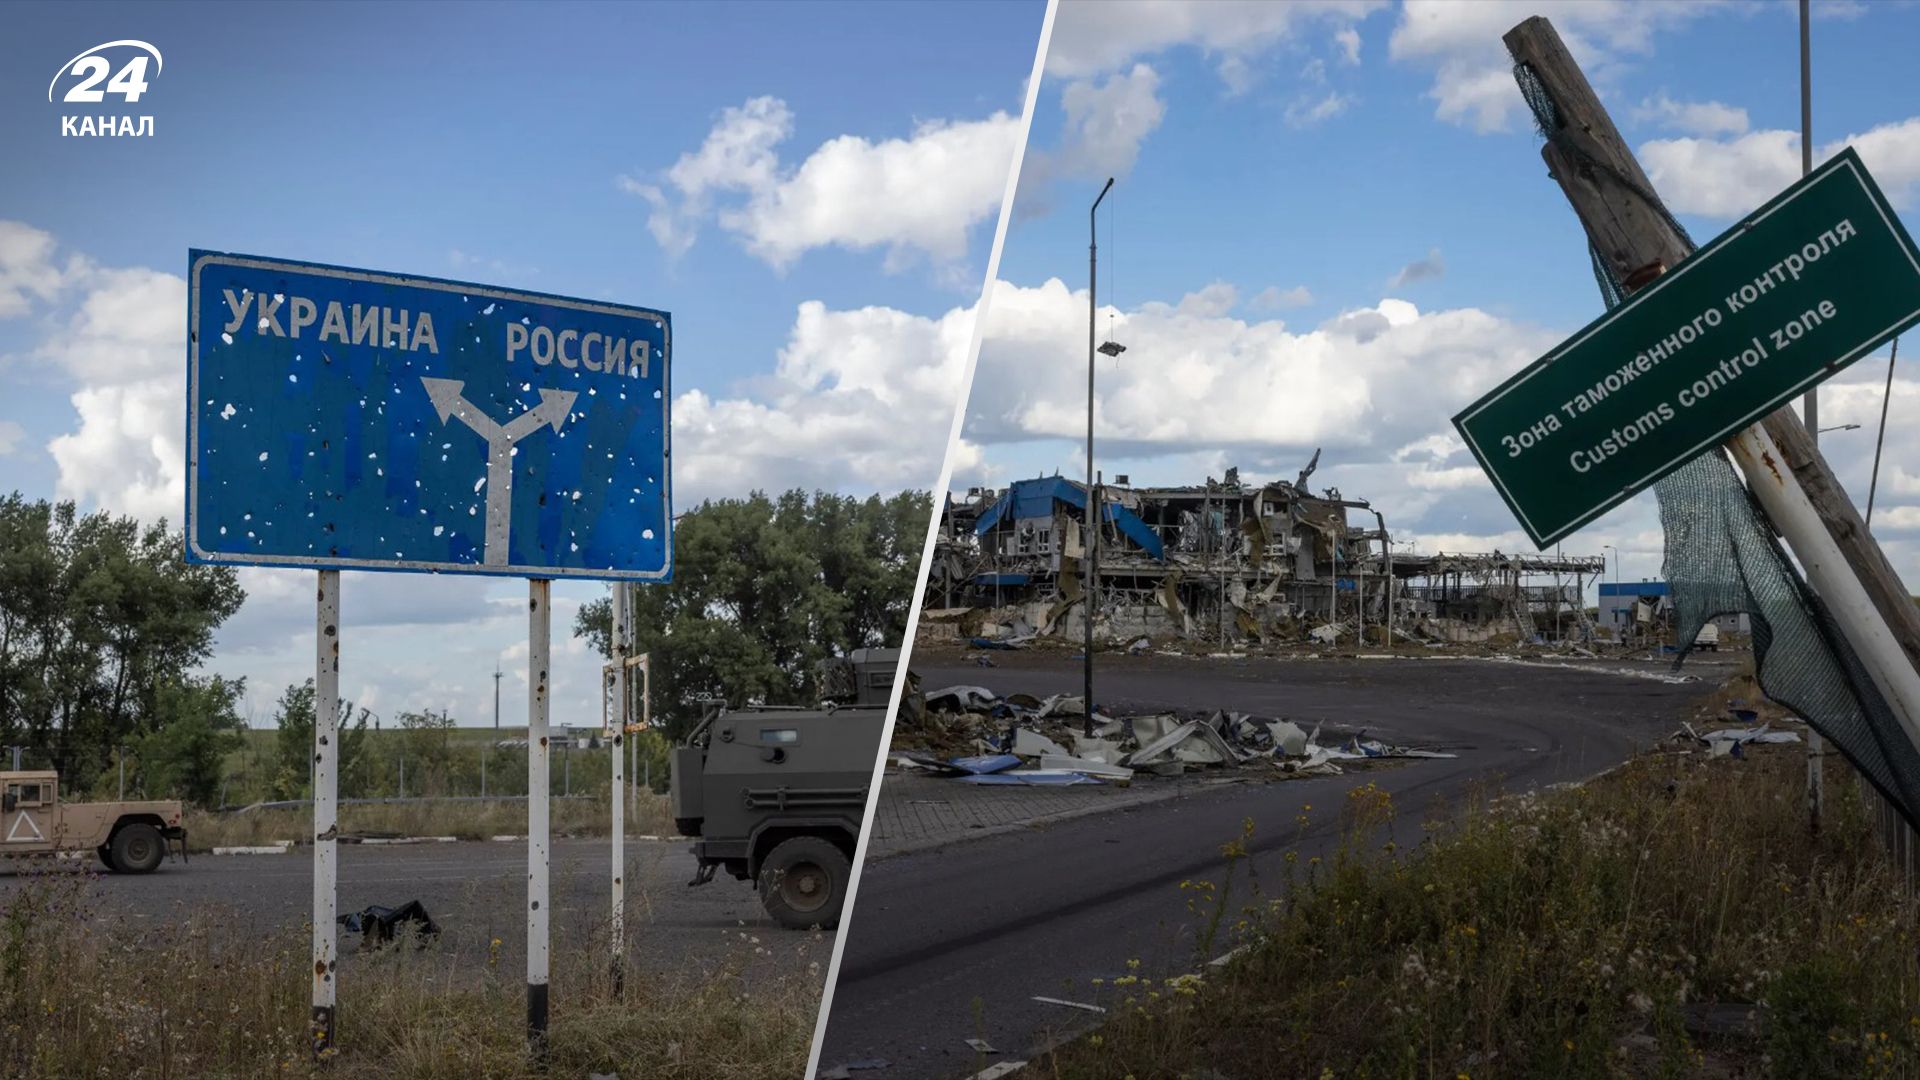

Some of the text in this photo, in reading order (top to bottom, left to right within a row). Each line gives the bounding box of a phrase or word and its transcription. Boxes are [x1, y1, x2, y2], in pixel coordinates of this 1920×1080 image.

[222, 288, 650, 379] УКРАИНА РОССИЯ
[1502, 218, 1858, 459] Зона таможенного контроля
[1569, 299, 1838, 473] Customs control zone
